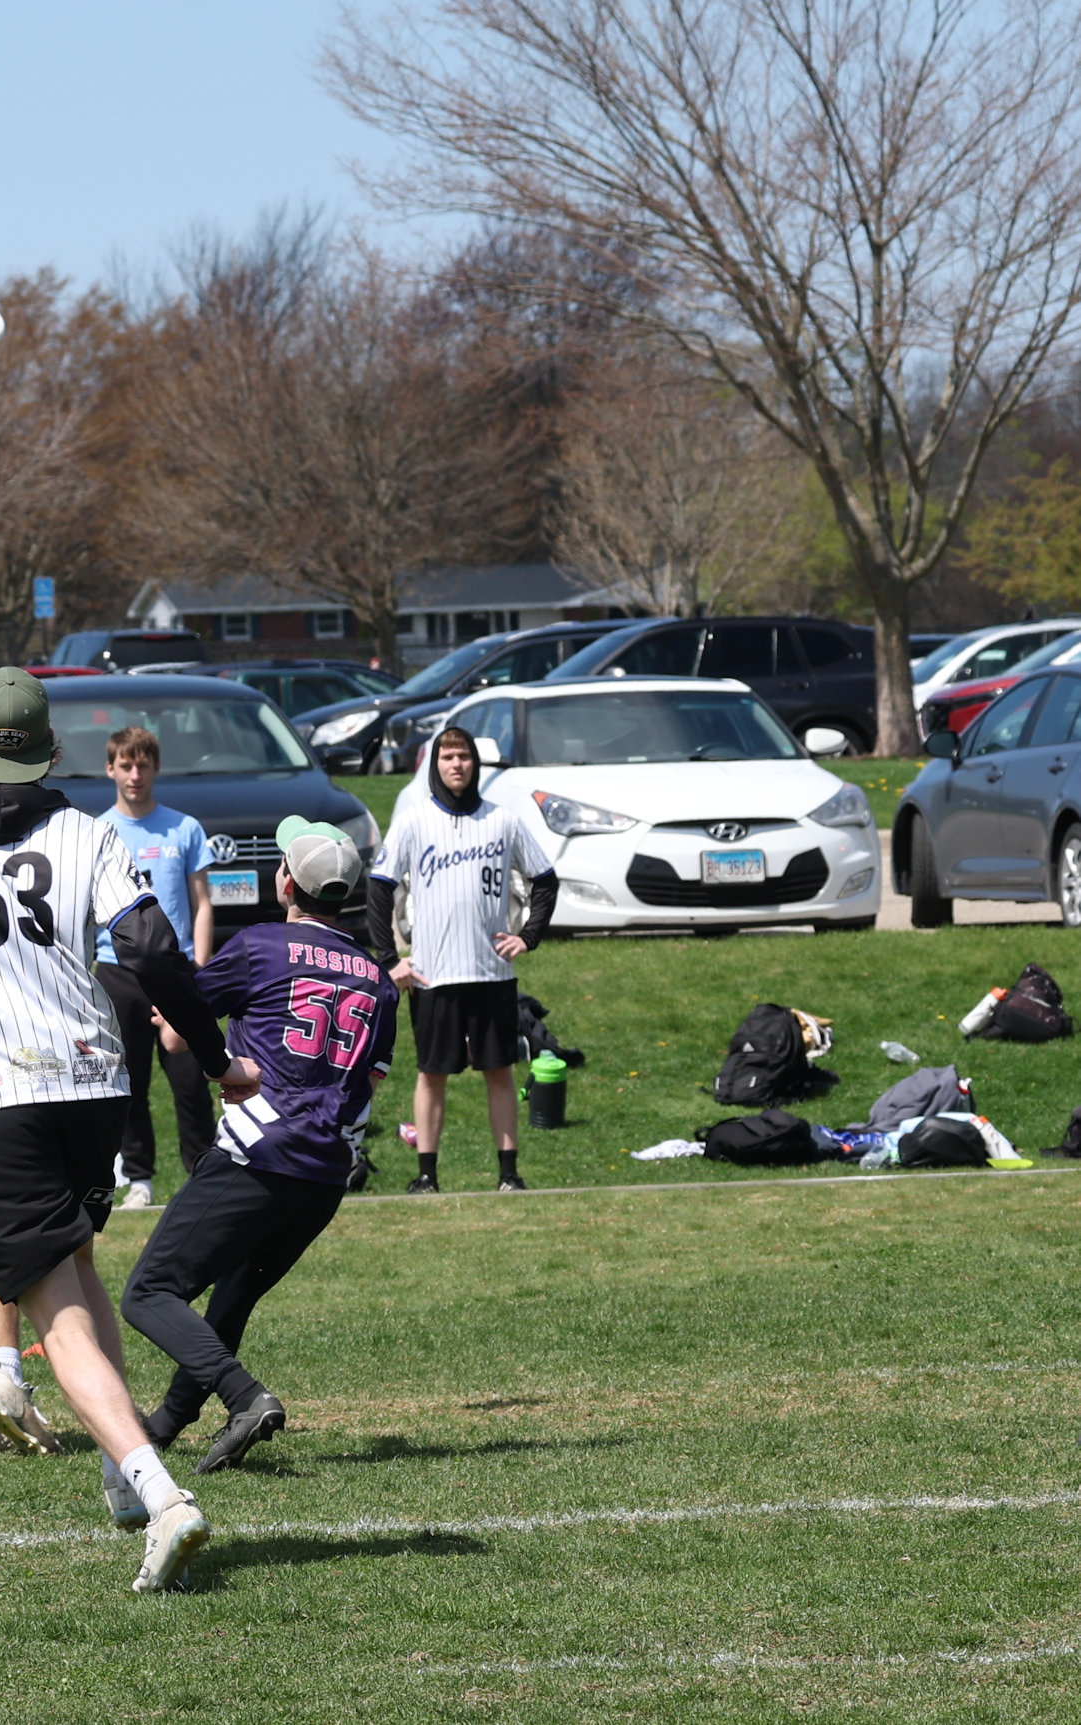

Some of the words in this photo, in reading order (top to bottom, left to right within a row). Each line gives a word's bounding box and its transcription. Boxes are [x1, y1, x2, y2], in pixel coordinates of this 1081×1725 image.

[10, 731, 26, 739] SEAS
[419, 837, 504, 888] Gnomes
[481, 865, 503, 898] 99
[282, 977, 378, 1070] 55
